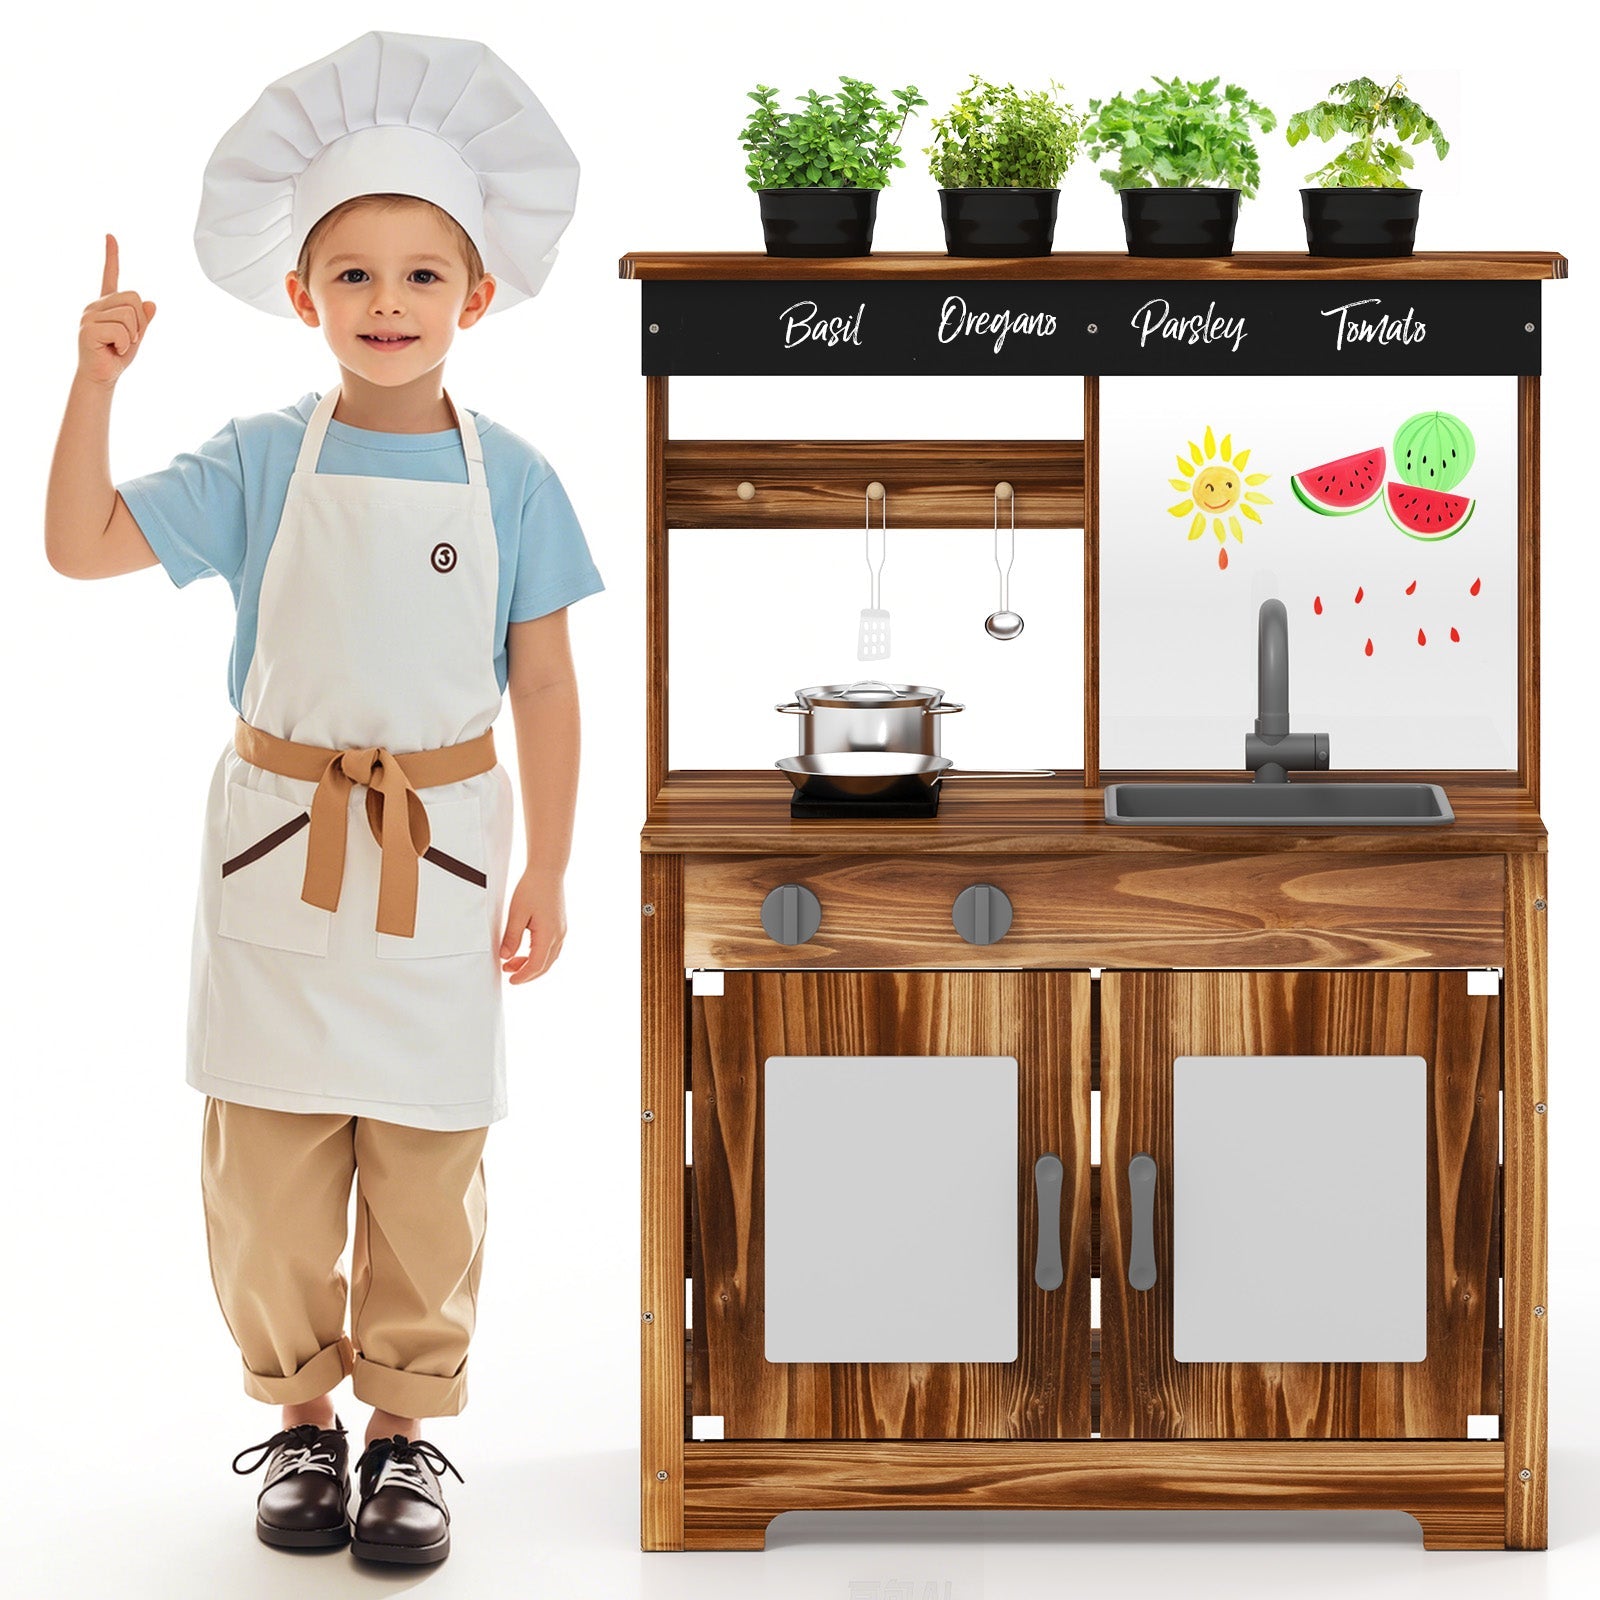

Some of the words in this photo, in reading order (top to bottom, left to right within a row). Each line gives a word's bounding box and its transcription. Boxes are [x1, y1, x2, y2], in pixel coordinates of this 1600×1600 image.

[780, 301, 864, 348] Basil
[937, 295, 1057, 354] Oregano
[1131, 299, 1248, 352] Parsley
[1321, 298, 1427, 350] Tomato
